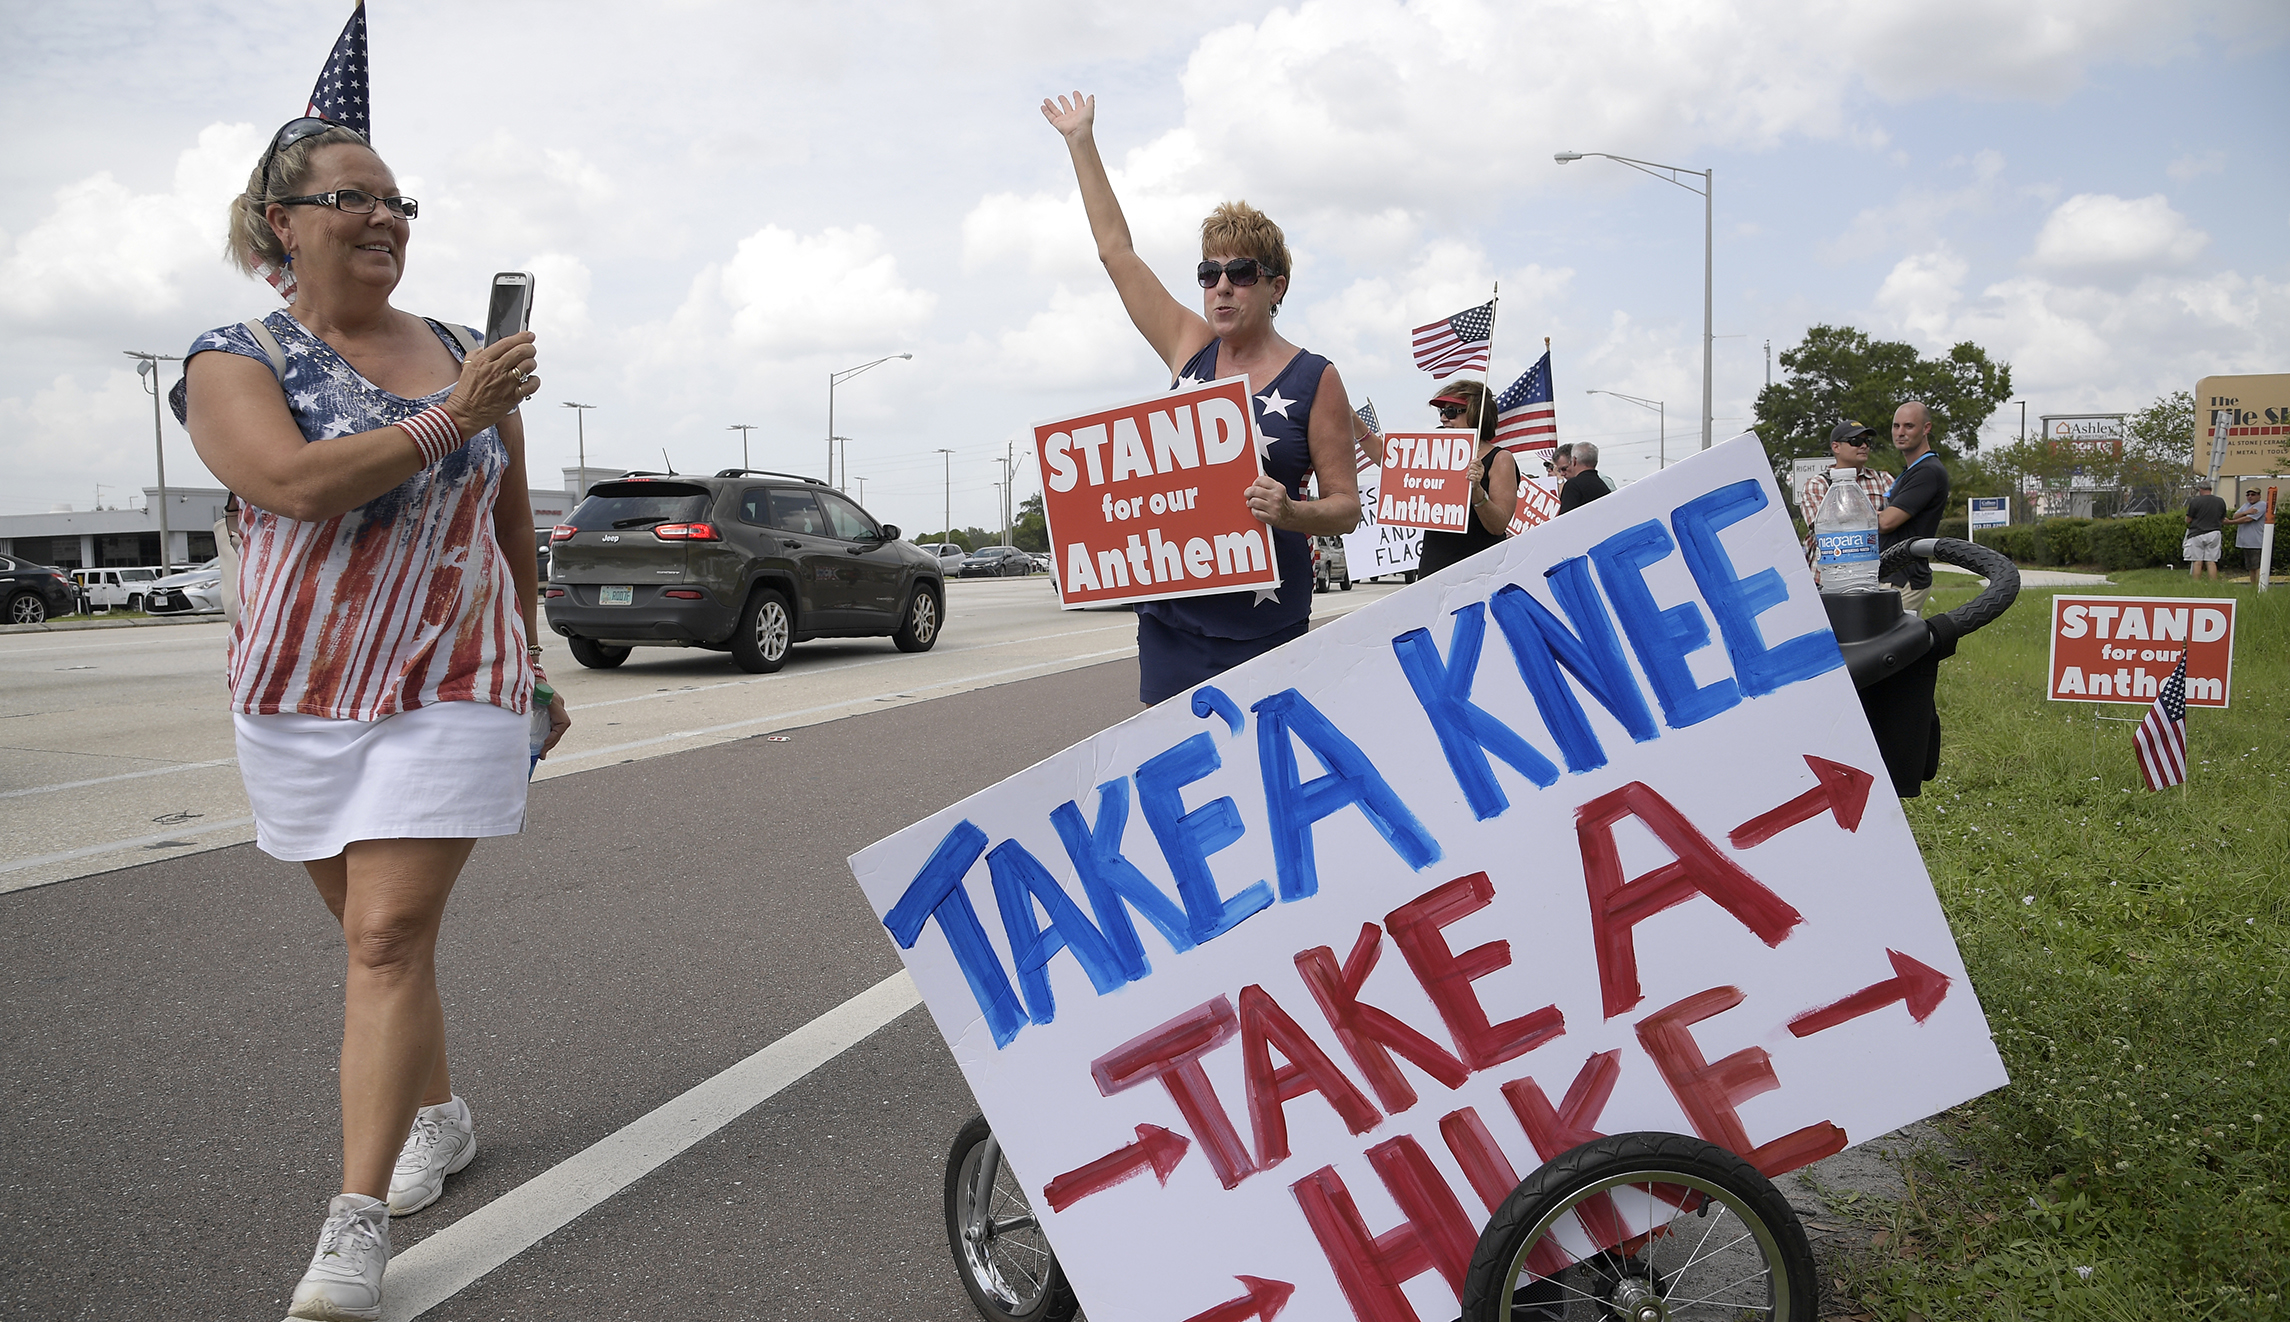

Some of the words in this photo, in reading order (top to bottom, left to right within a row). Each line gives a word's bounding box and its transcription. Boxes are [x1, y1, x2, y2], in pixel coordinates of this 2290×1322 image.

[2206, 408, 2258, 426] Tle
[2209, 396, 2239, 406] The
[1049, 397, 1246, 492] STAND
[2071, 422, 2115, 434] Ashley
[1384, 437, 1471, 471] STAND
[1403, 473, 1422, 489] for
[1423, 477, 1445, 490] our
[1102, 493, 1143, 522] for
[1149, 487, 1198, 515] our
[1379, 494, 1465, 526] Anthem
[1516, 480, 1561, 520] STAN
[1523, 506, 1537, 520] for
[1380, 526, 1417, 545] AND
[1818, 534, 1864, 552] niagara
[1068, 528, 1267, 593] Anthem
[2060, 605, 2227, 643] STAND
[1391, 478, 1846, 822] KNEE
[2102, 643, 2137, 661] for
[2140, 649, 2182, 663] our
[1091, 871, 1566, 1191] TAKE
[1572, 780, 1805, 1020] A
[1288, 985, 1849, 1322] HIKE
